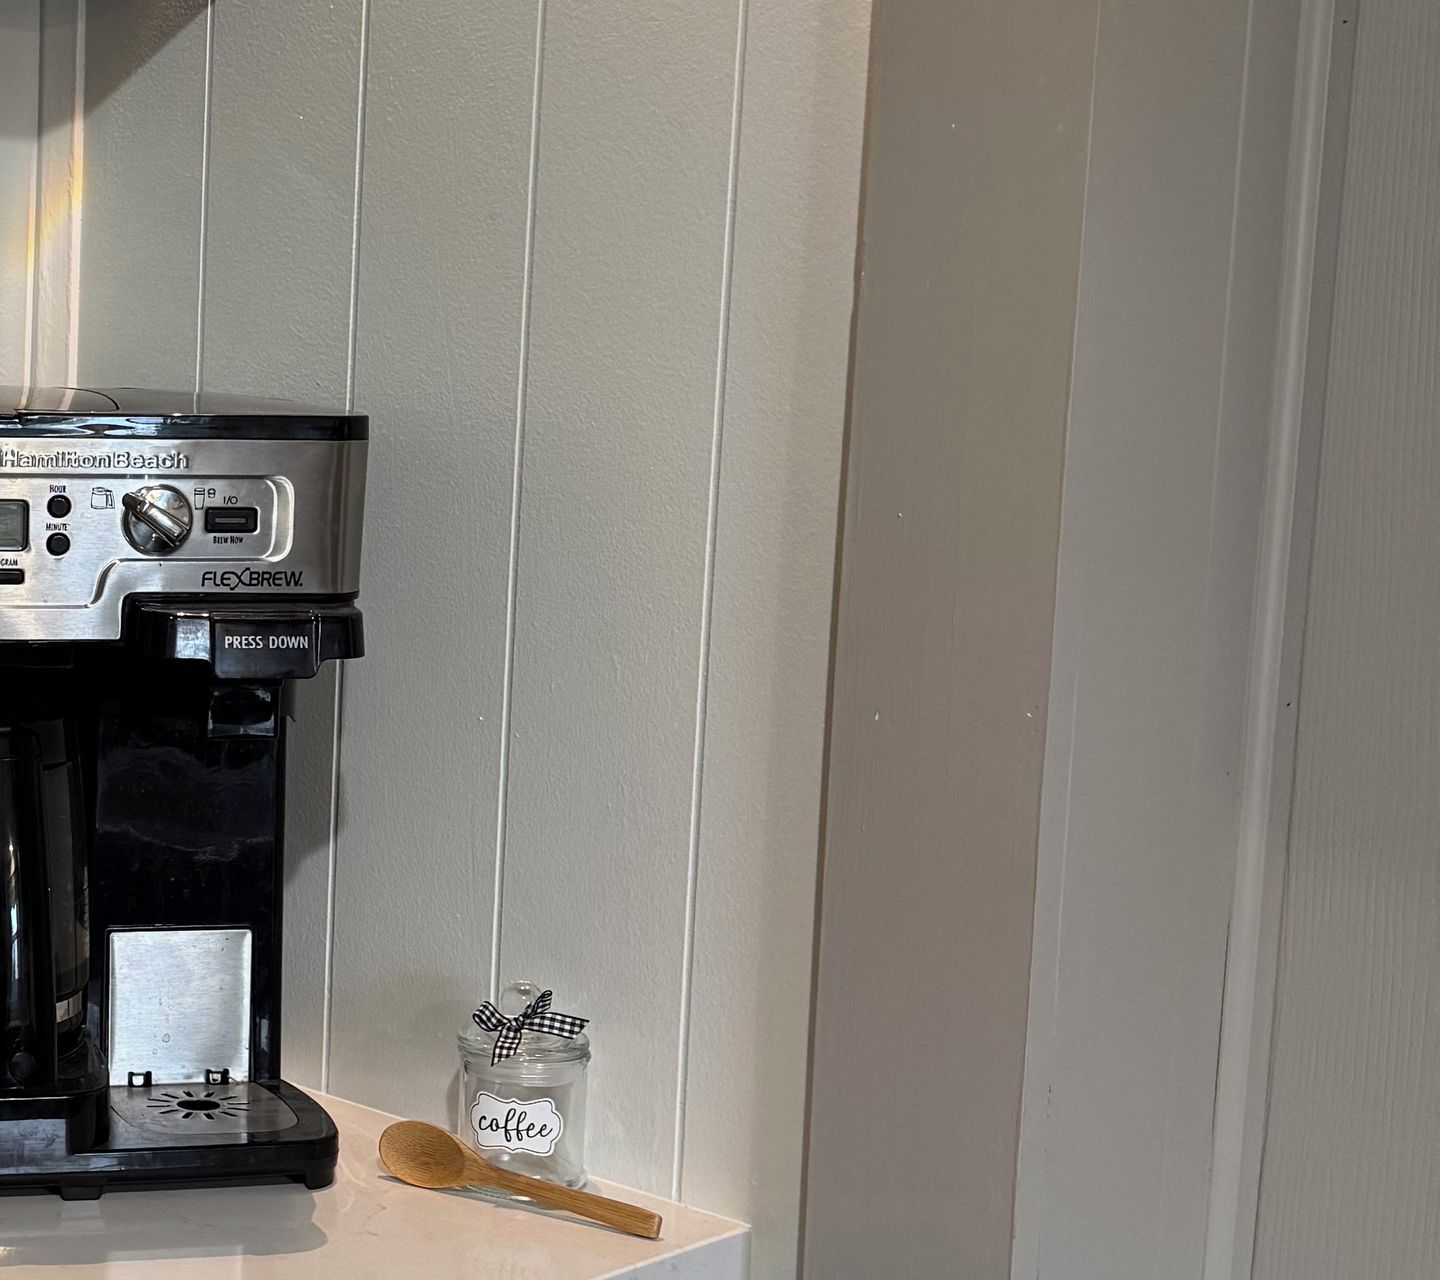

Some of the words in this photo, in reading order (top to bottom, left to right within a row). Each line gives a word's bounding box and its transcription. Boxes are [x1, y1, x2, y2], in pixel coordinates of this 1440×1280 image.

[0, 447, 111, 469] Hamilton
[112, 450, 190, 469] Beach
[224, 635, 264, 649] PRESS
[269, 635, 309, 649] DOWN
[478, 1107, 553, 1143] coffee
